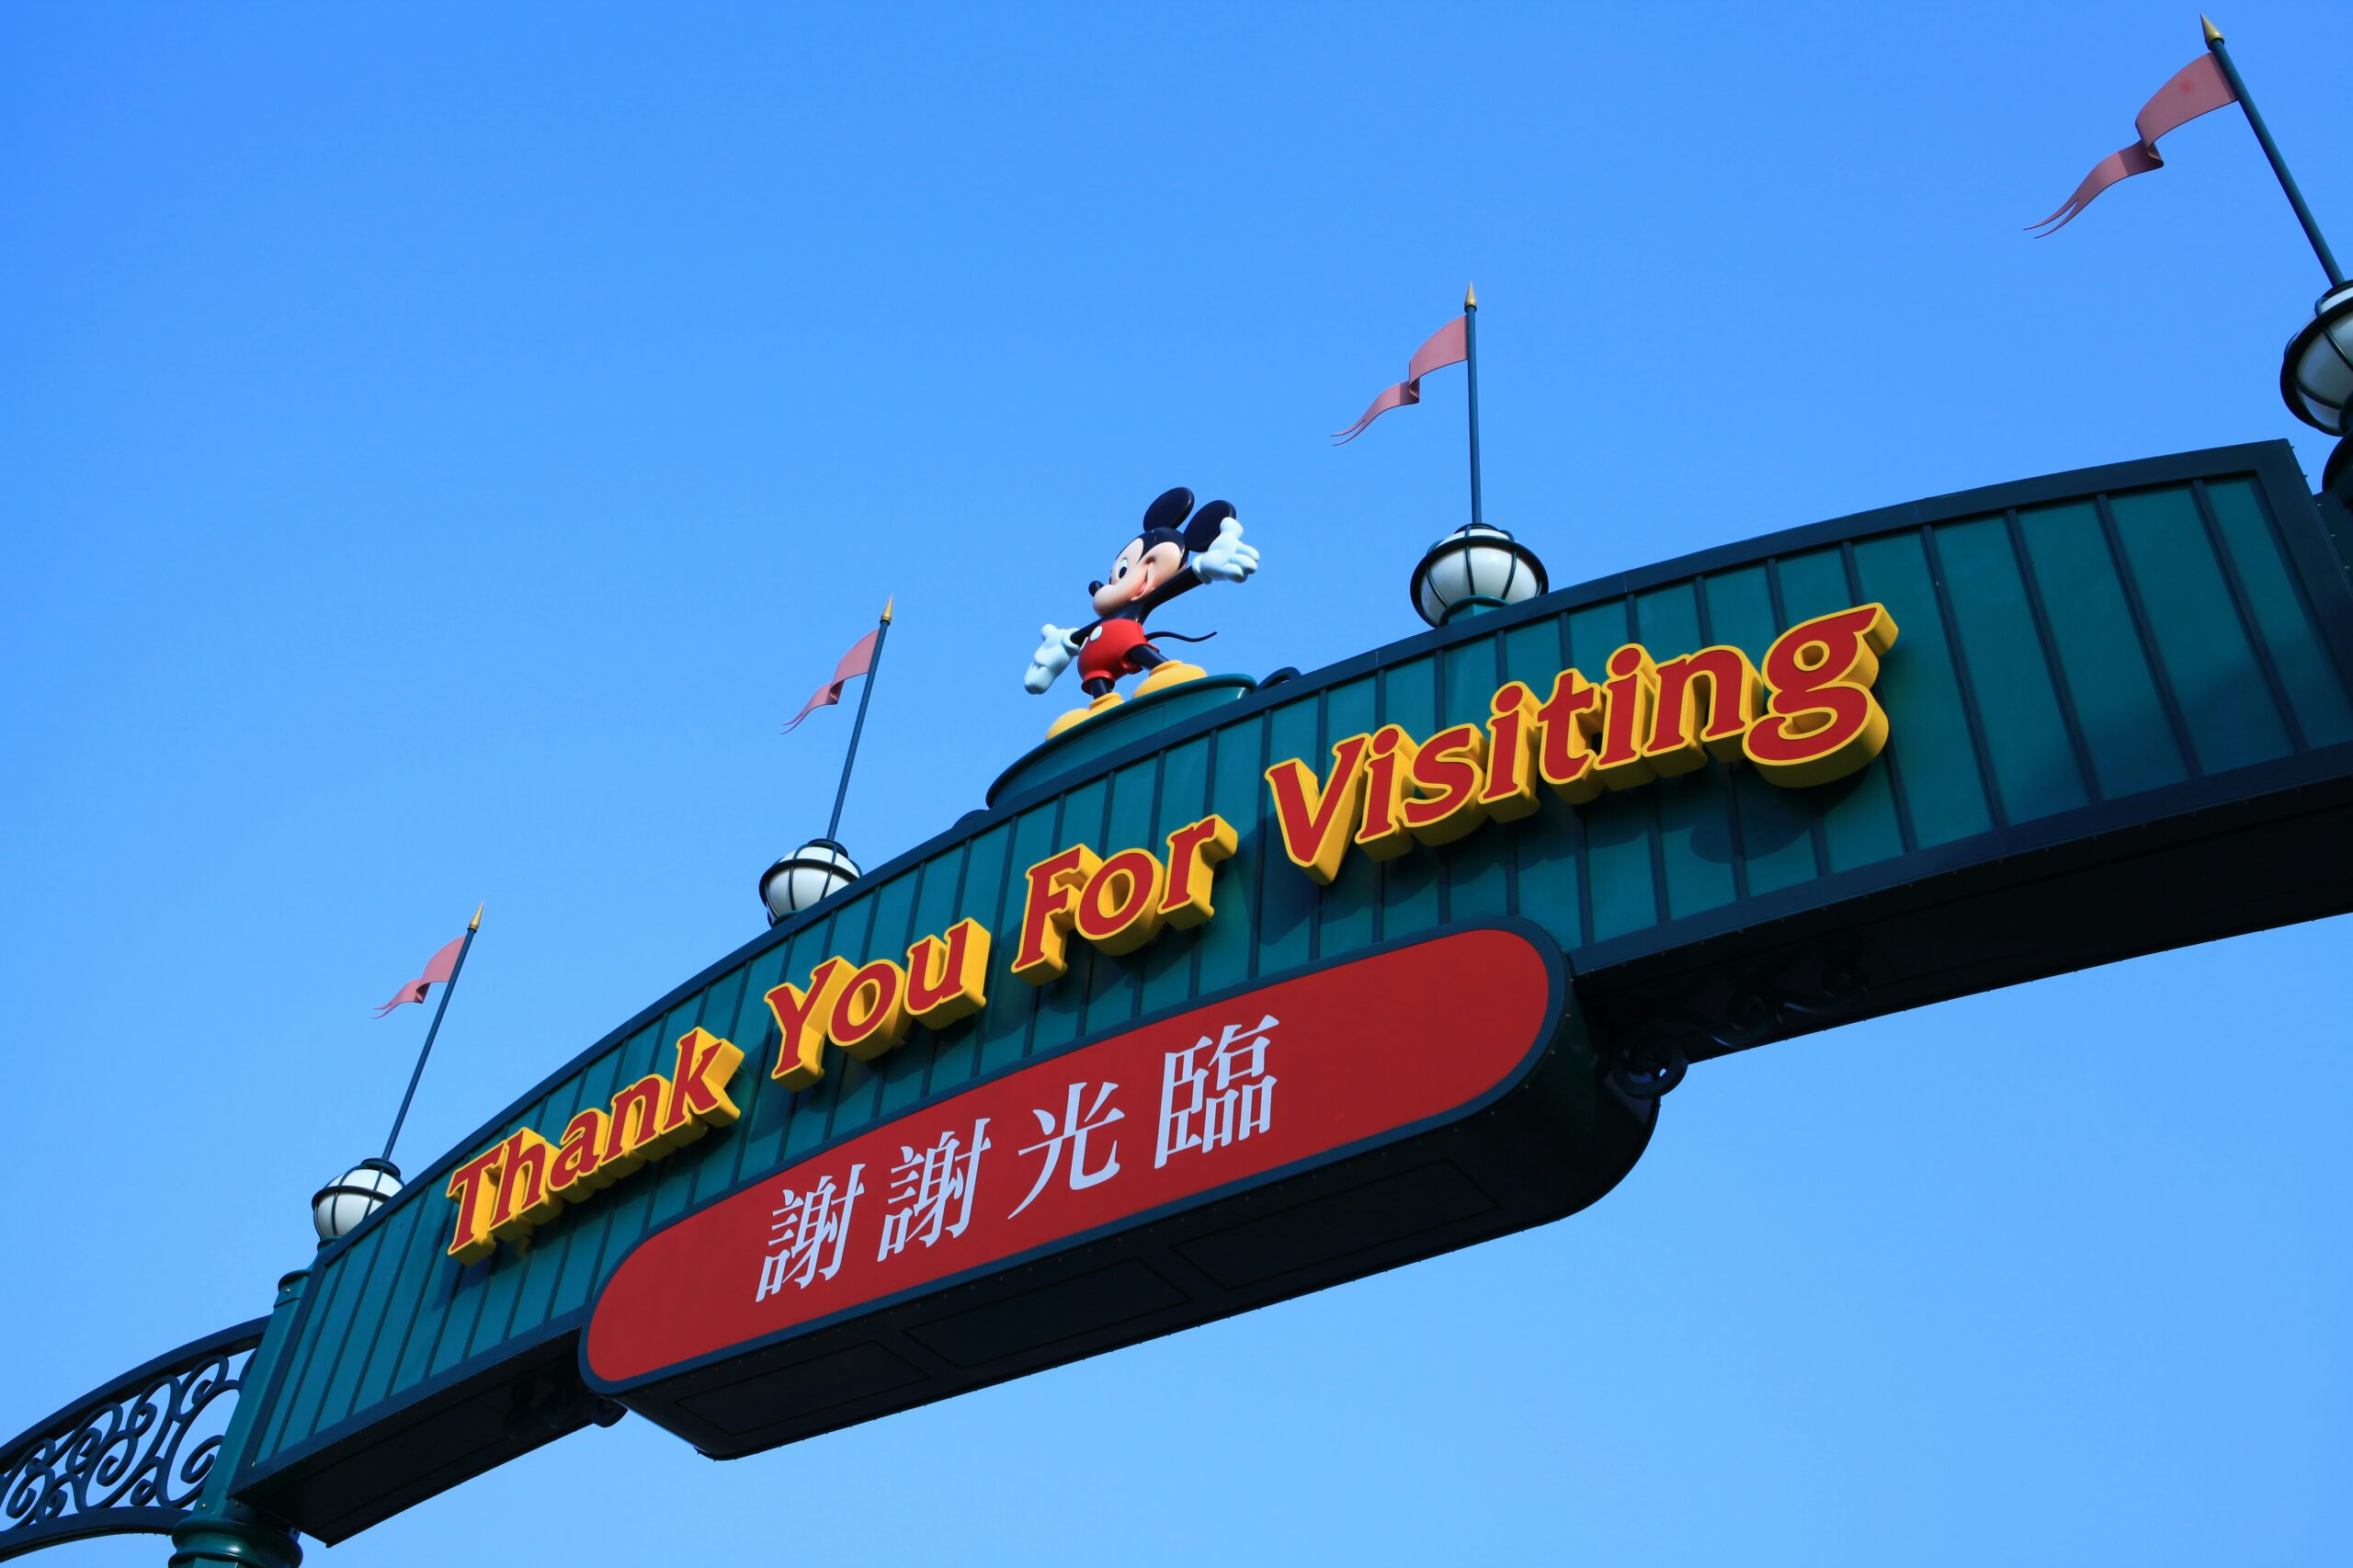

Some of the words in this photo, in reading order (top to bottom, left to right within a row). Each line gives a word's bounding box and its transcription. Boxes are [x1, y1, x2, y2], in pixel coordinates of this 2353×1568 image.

[446, 1026, 744, 1265] Thank
[764, 917, 991, 1090] You
[1010, 813, 1239, 984] For
[1263, 602, 1899, 883] Visiting
[755, 1014, 1279, 1302] 謝謝光臨
